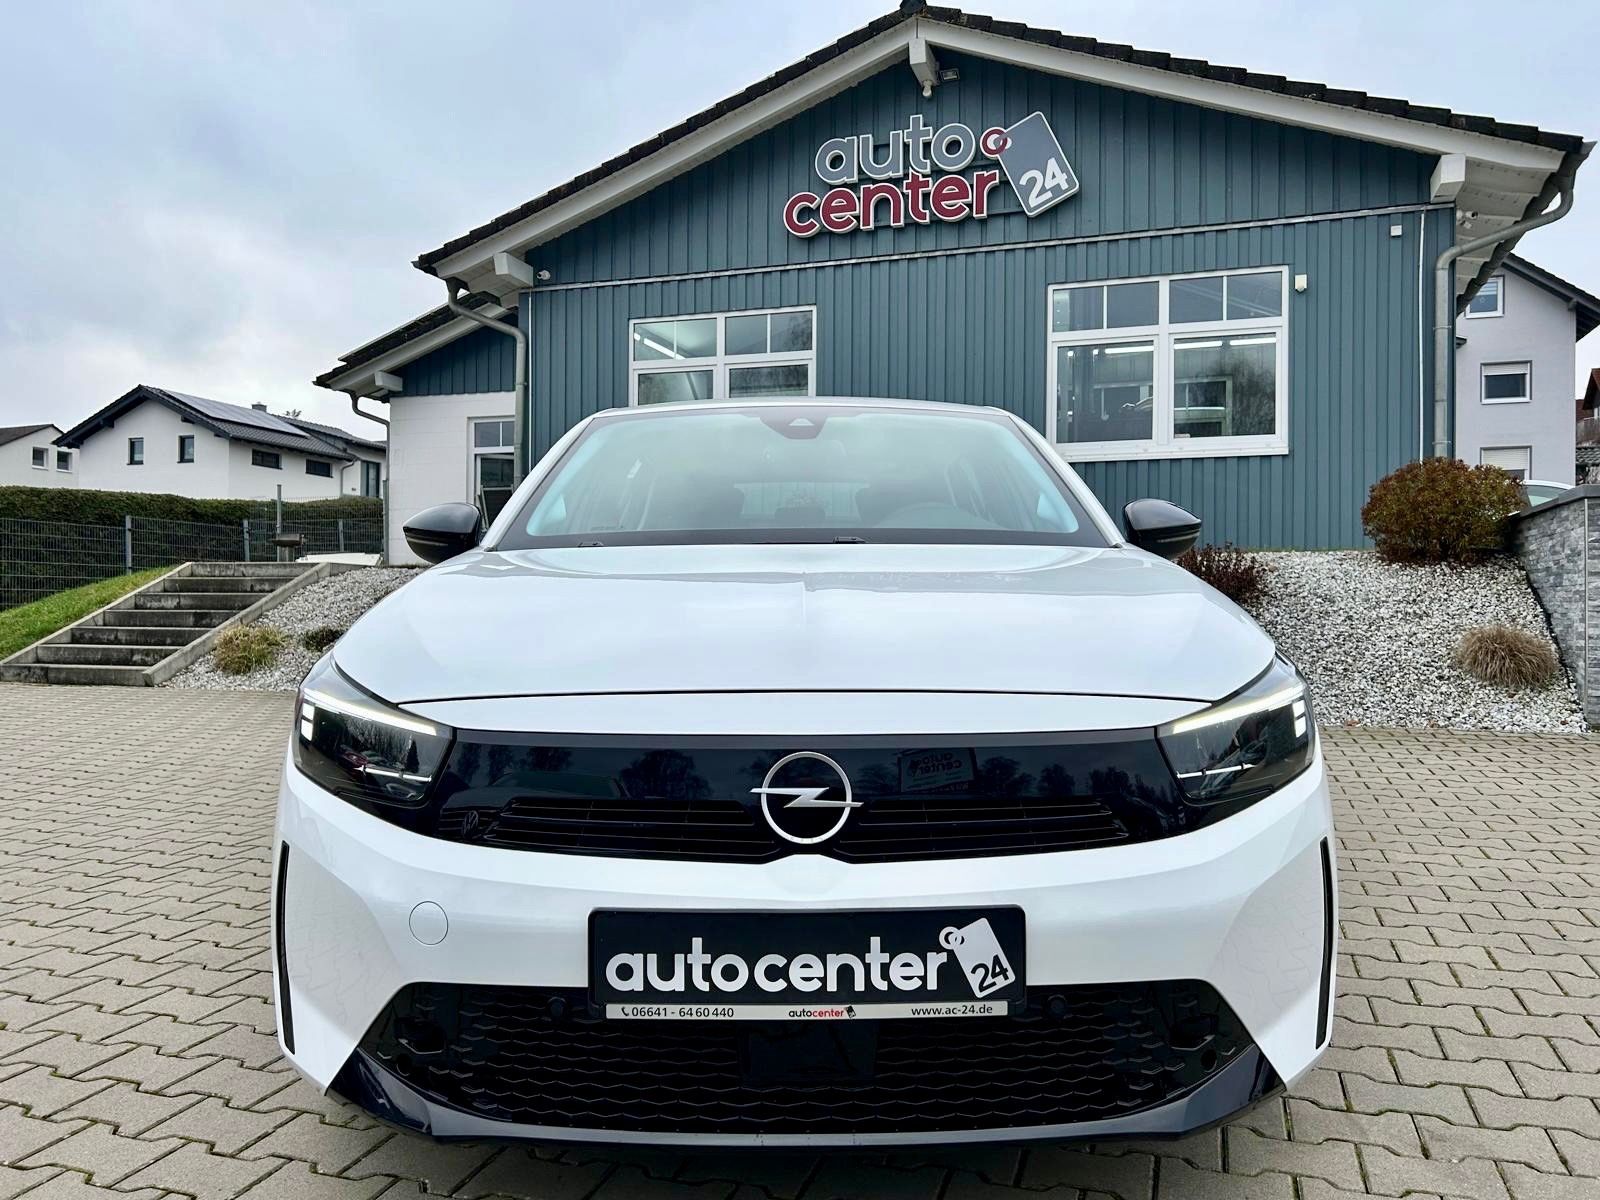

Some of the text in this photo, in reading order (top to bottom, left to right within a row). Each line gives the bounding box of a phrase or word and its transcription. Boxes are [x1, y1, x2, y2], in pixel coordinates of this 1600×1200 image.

[815, 114, 976, 185] auto
[784, 168, 1000, 237] center
[1019, 157, 1068, 208] 24
[606, 936, 1009, 993] autocenter 24
[631, 1007, 667, 1017] 06641
[788, 1008, 844, 1018] autocenter
[911, 1003, 993, 1016] www.ac-24.de
